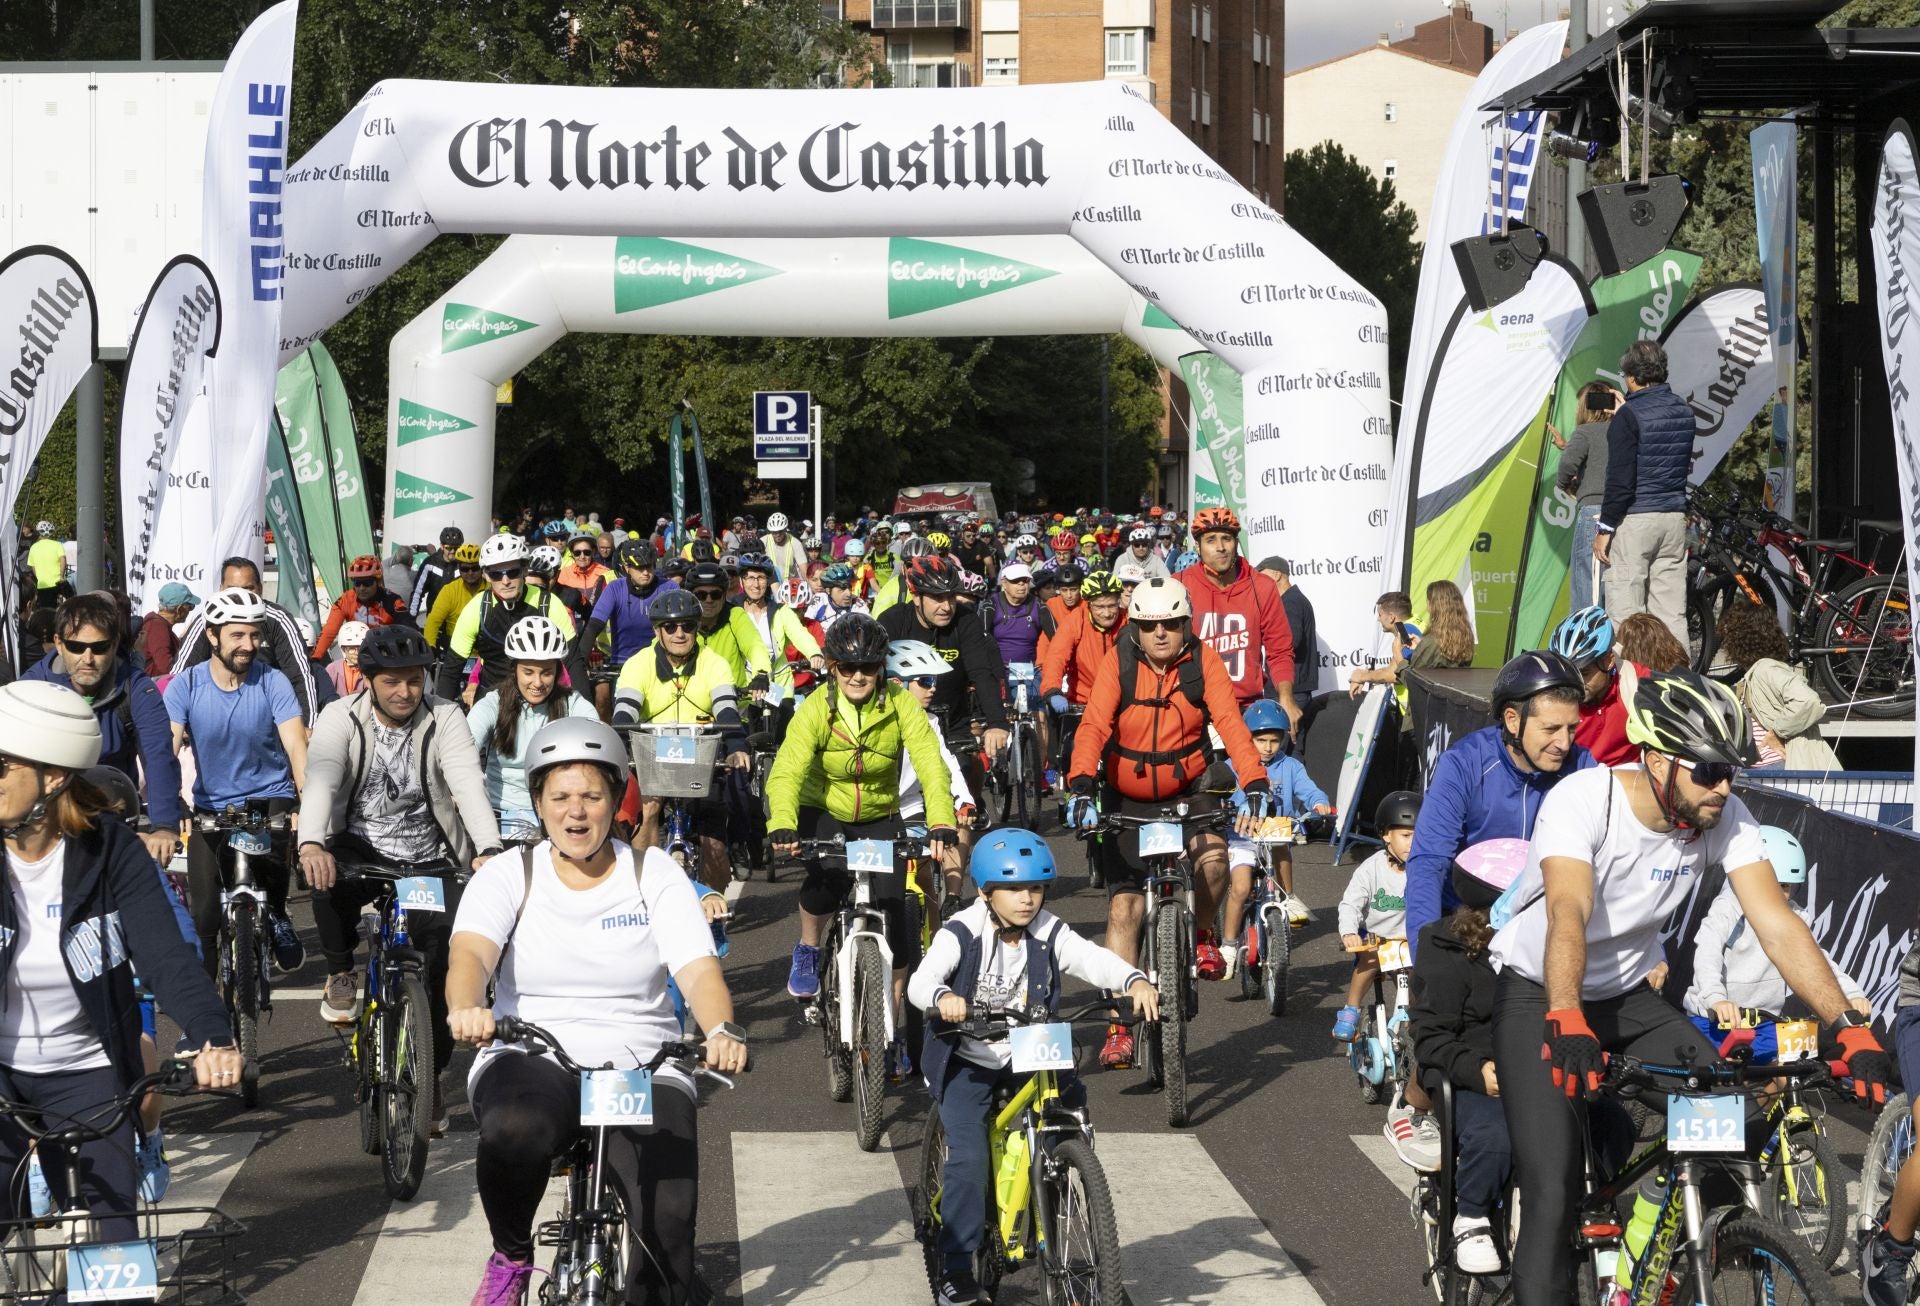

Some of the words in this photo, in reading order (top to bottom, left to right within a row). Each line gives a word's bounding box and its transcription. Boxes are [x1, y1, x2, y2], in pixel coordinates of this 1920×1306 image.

[448, 118, 533, 189] El
[539, 118, 712, 193] Norte
[721, 126, 788, 193] de
[798, 120, 1050, 193] Castilla
[313, 166, 327, 181] de
[329, 163, 390, 183] Castilla
[1109, 159, 1128, 178] El
[1132, 158, 1173, 176] Norte
[1175, 160, 1190, 176] de
[249, 83, 285, 301] MAHLE
[357, 209, 378, 228] El
[382, 209, 422, 228] Norte
[1083, 205, 1142, 223] Castilla
[1231, 203, 1250, 218] El
[304, 253, 319, 270] de
[322, 252, 382, 271] Castilla
[1121, 248, 1140, 264] El
[1141, 247, 1181, 265] Norte
[1184, 246, 1201, 263] de
[1202, 242, 1265, 262] Castilla
[635, 257, 682, 278] Corte
[682, 254, 748, 286] Inglés
[910, 262, 957, 281] Corte
[957, 257, 1021, 289] Inglés
[1240, 285, 1260, 305] El
[1265, 284, 1306, 301] Norte
[1308, 284, 1324, 301] de
[1326, 284, 1377, 309] Castilla
[455, 320, 480, 332] Corte
[480, 318, 518, 334] Inglés
[1500, 313, 1534, 326] aena
[1216, 330, 1275, 348] Castilla
[1358, 325, 1373, 343] El
[156, 284, 214, 430] Castilla
[1695, 303, 1769, 438] Castilla
[1258, 376, 1273, 396] El
[1274, 374, 1313, 393] Norte
[1315, 372, 1332, 389] de
[1334, 370, 1382, 389] Castilla
[406, 416, 427, 428] Corte
[767, 395, 797, 431] P
[1364, 416, 1378, 436] El
[168, 472, 183, 489] de
[1261, 468, 1276, 488] El
[1278, 466, 1318, 485] Norte
[1321, 464, 1337, 482] de
[1340, 462, 1387, 482] Castilla
[403, 489, 423, 501] Corte
[1367, 509, 1383, 528] El
[165, 563, 181, 581] de
[1325, 558, 1342, 574] de
[1331, 650, 1348, 667] de
[667, 747, 684, 759] 64
[238, 838, 264, 851] 830
[1146, 834, 1174, 850] 272
[855, 852, 885, 867] 271
[407, 889, 436, 905] 405
[601, 913, 650, 931] MAHLE
[1783, 1034, 1816, 1055] 1219
[1675, 1118, 1737, 1141] 1512
[86, 1262, 141, 1290] 979
